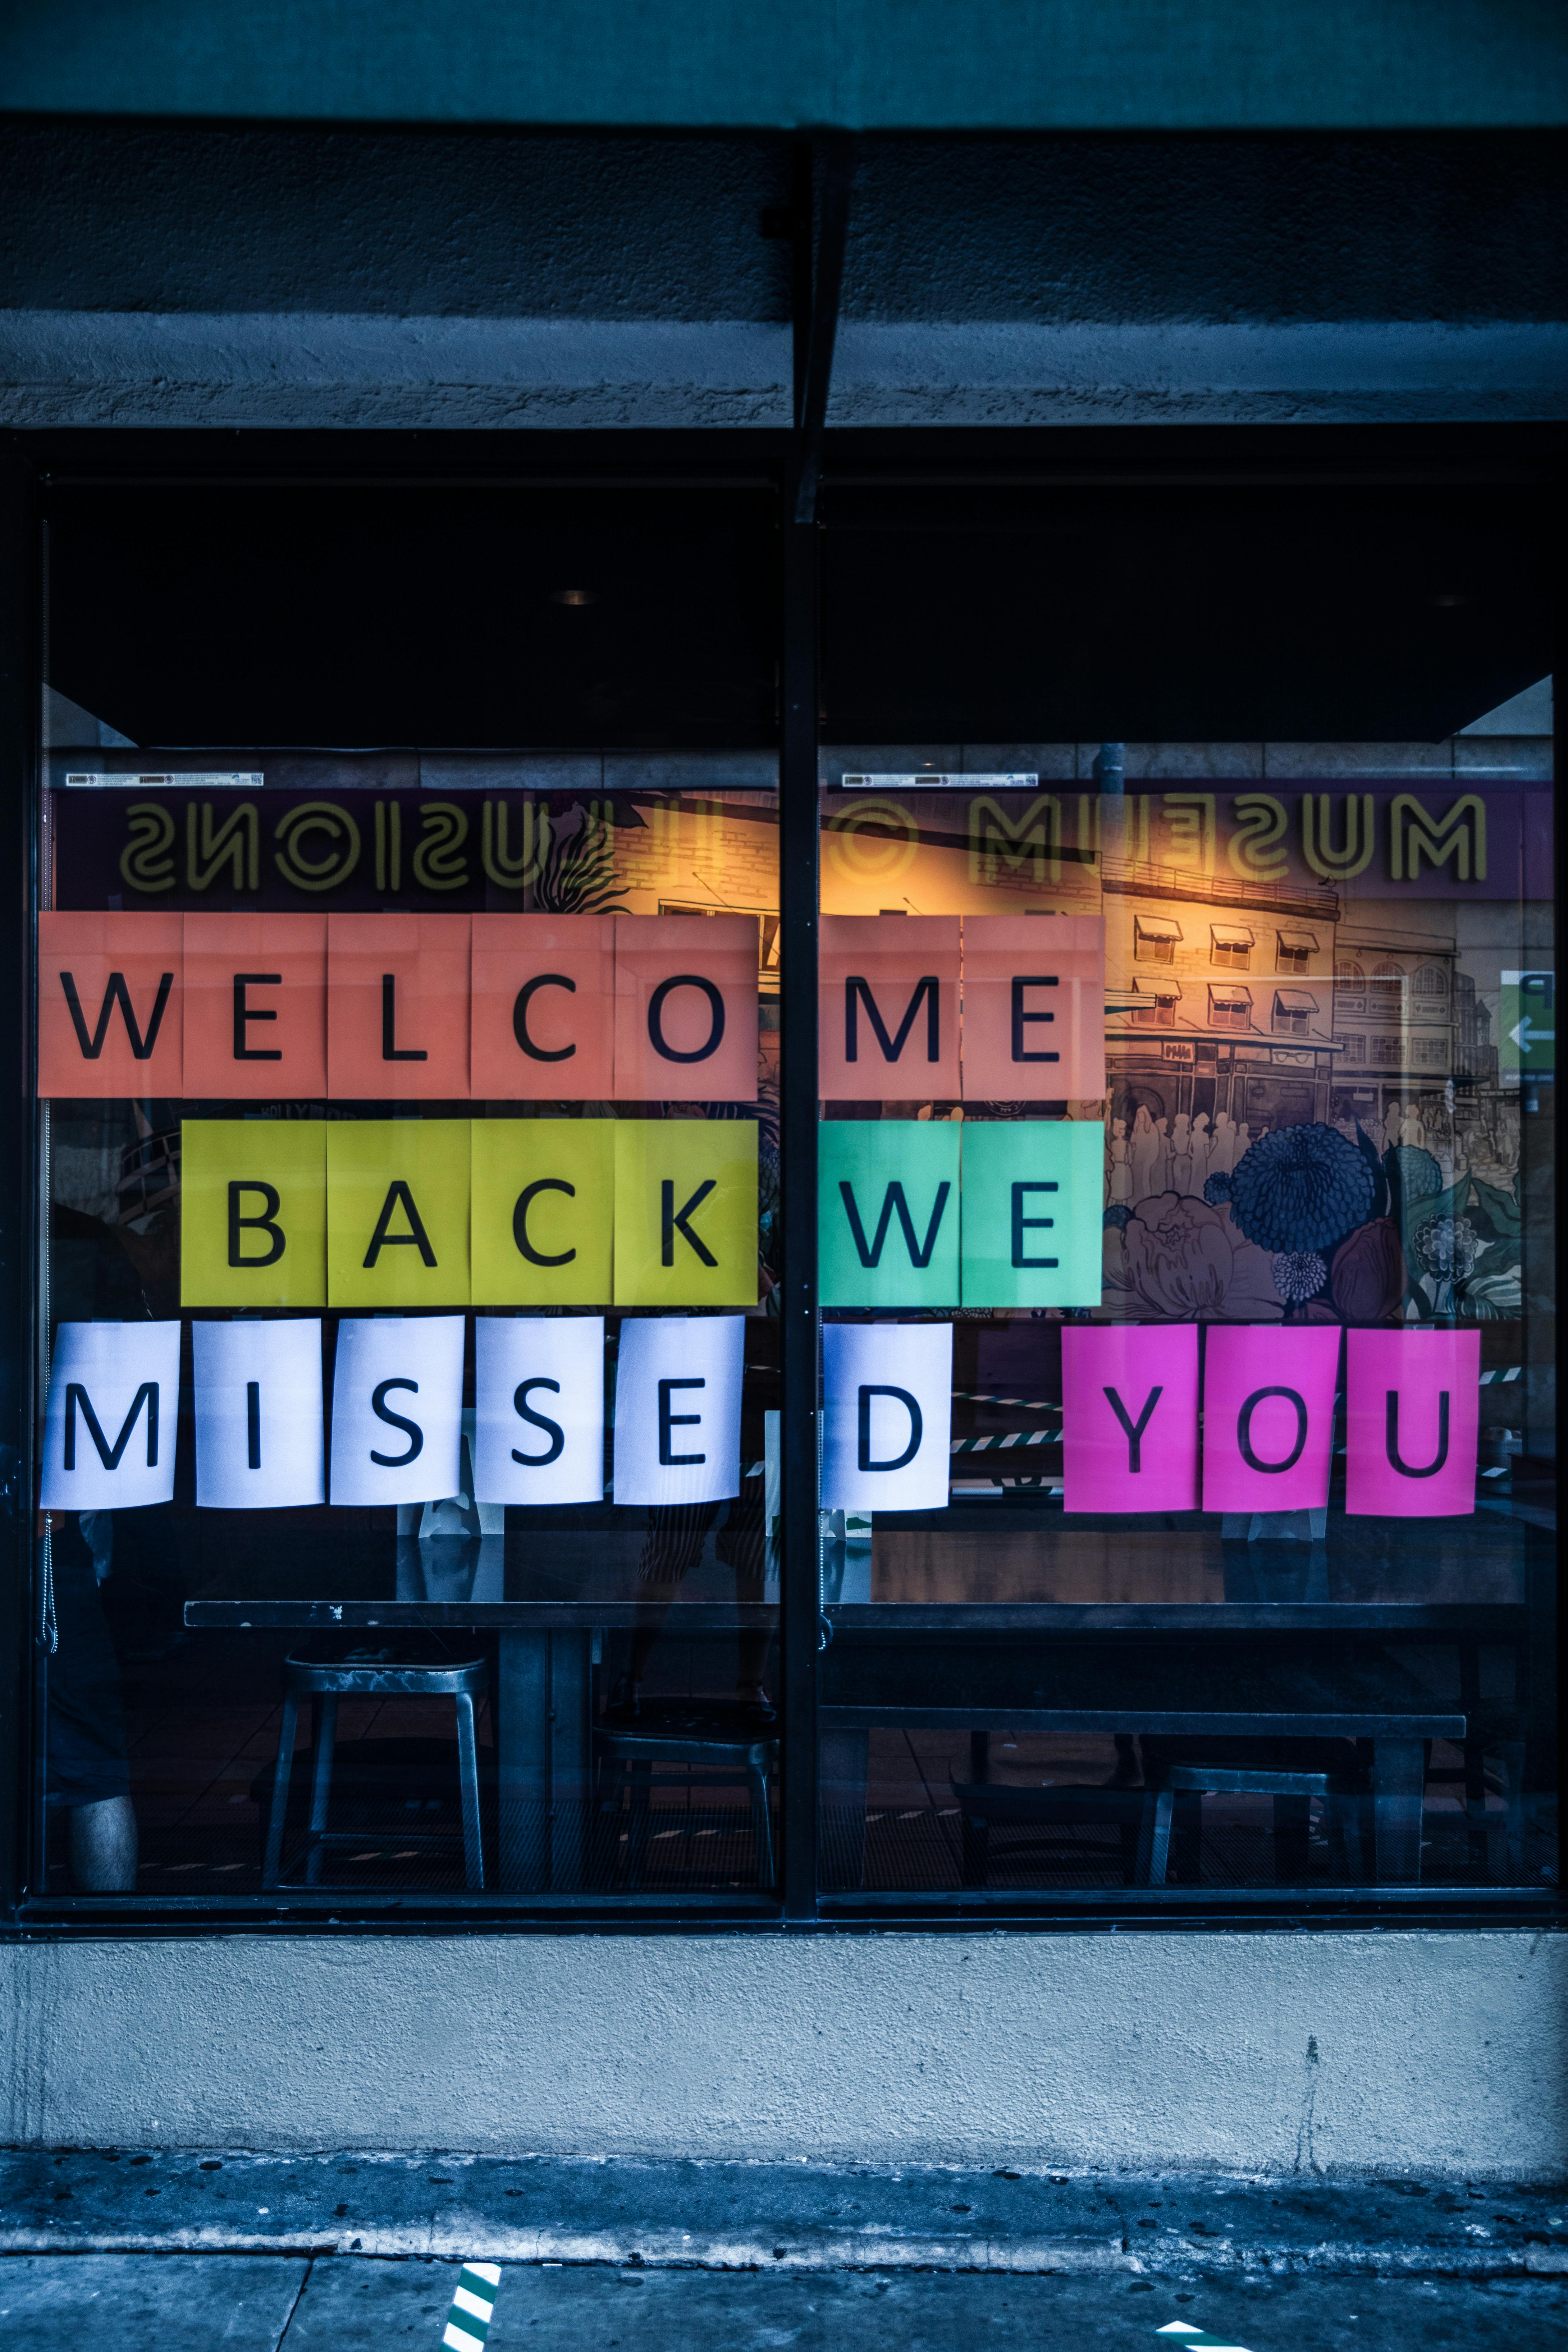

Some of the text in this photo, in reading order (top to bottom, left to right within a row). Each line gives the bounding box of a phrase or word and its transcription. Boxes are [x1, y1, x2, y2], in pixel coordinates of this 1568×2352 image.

[59, 972, 1060, 1063] WELCOME
[228, 1179, 1059, 1268] BACK WE
[64, 1378, 1450, 1478] MISSED YOU
